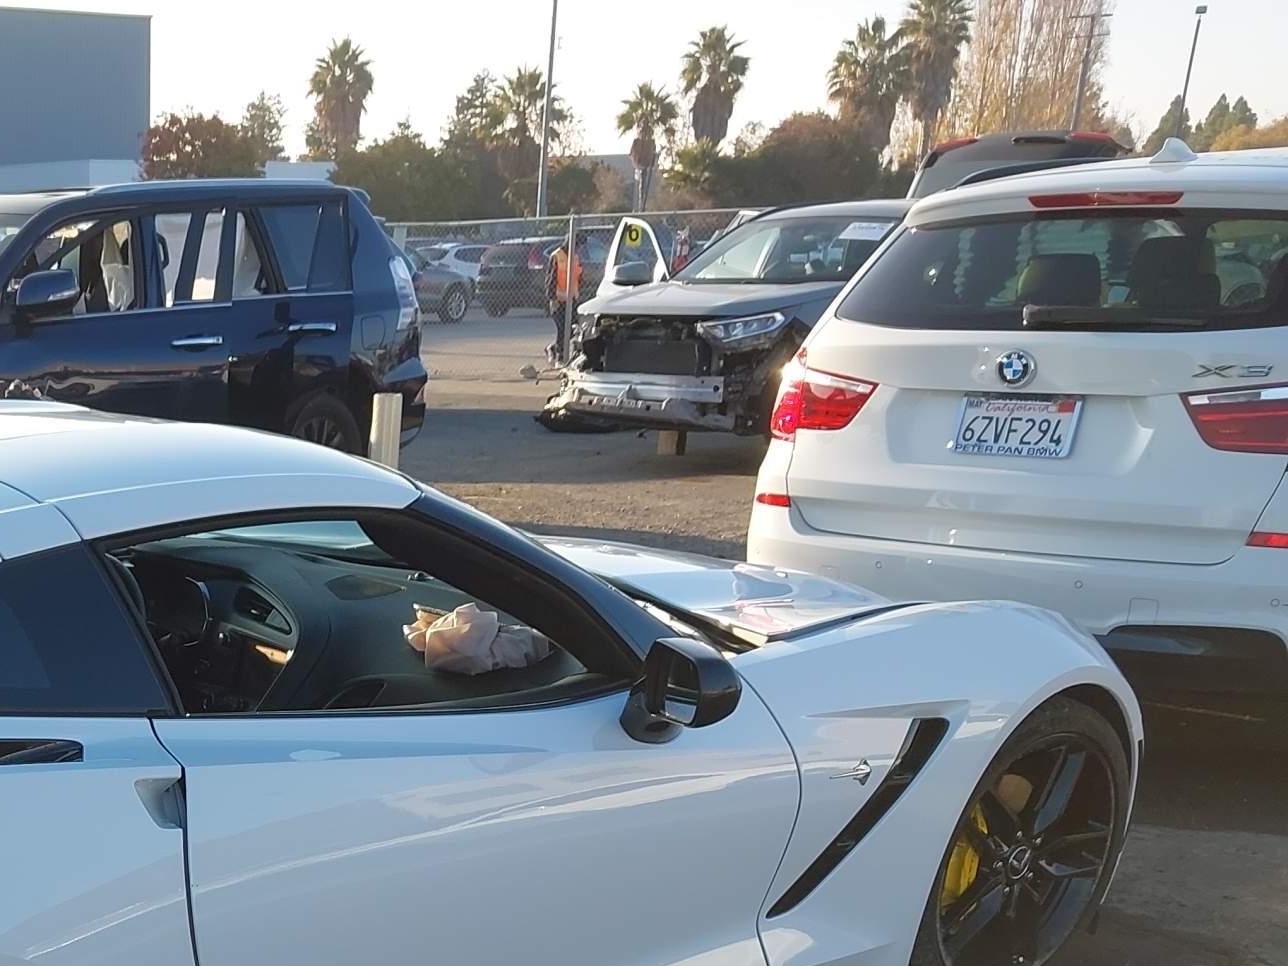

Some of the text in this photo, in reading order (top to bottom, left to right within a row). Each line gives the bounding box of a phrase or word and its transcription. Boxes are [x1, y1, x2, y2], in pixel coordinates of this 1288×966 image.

[1192, 364, 1274, 378] X3
[962, 416, 1062, 446] 6ZVF294
[955, 443, 1063, 457] PETER PAN BMW
